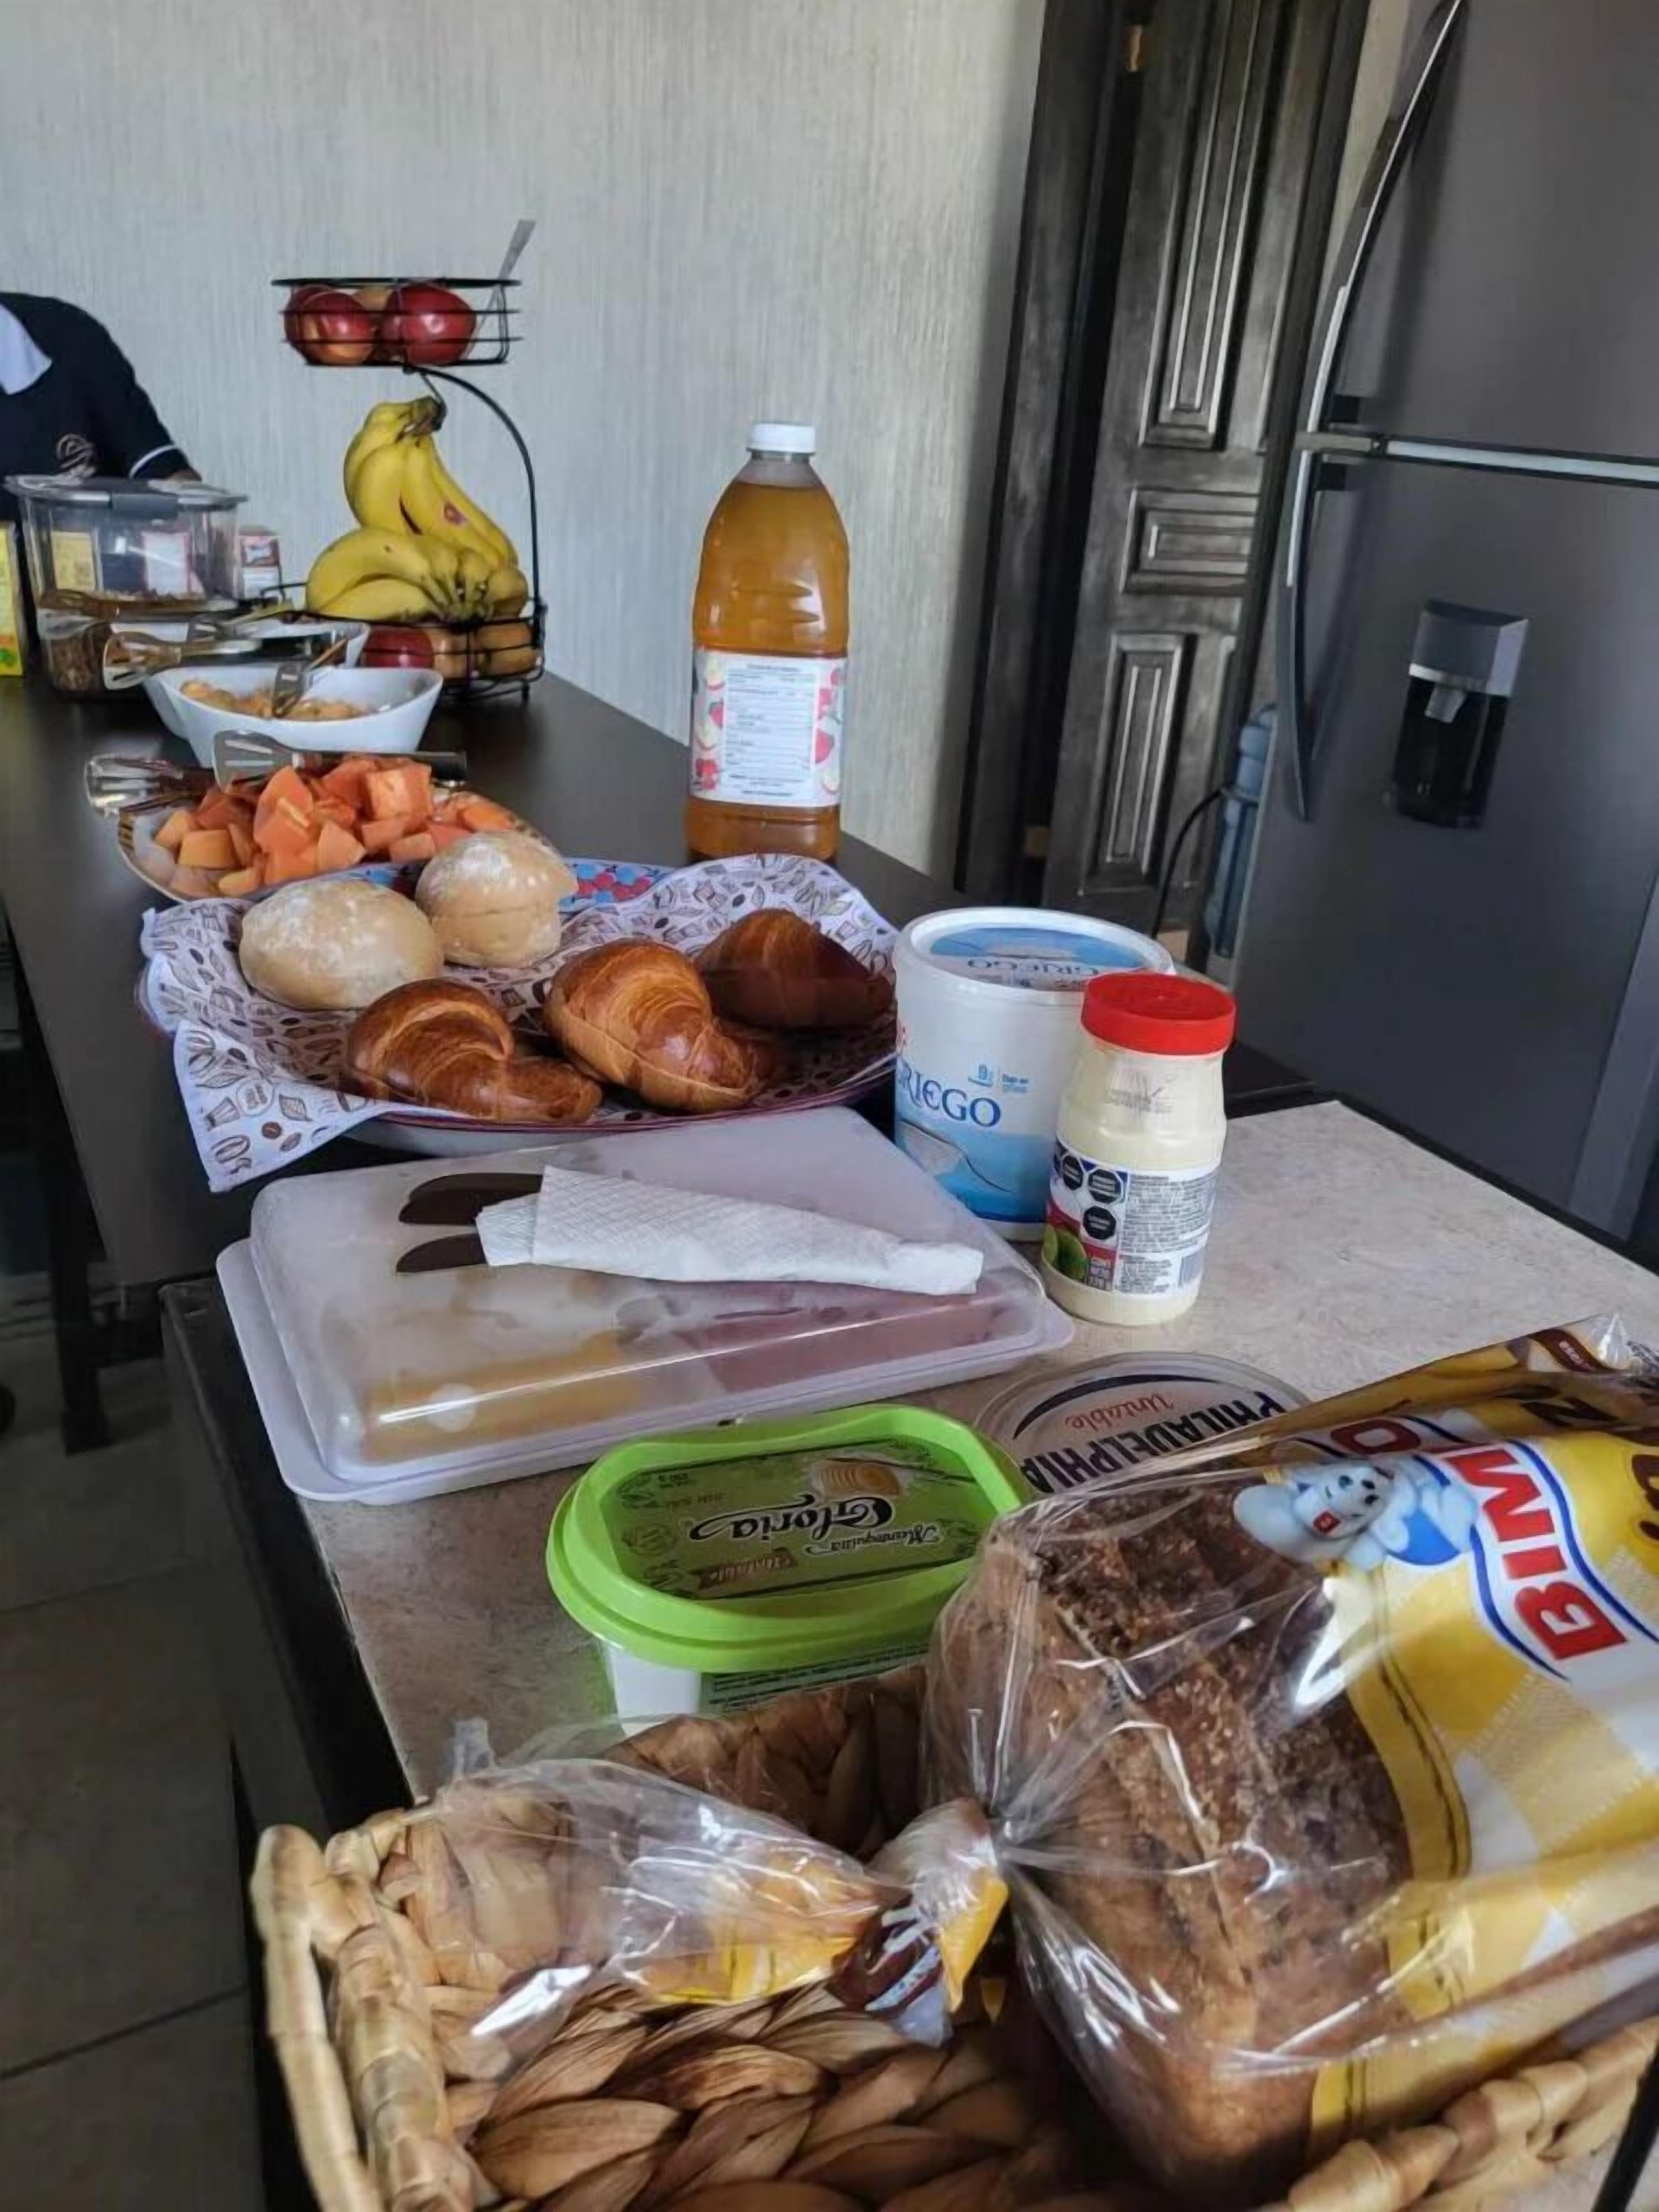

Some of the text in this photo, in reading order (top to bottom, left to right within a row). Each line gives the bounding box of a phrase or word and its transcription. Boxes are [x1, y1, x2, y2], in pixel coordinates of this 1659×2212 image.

[896, 1056, 1002, 1129] RIEGO
[1021, 1390, 1286, 1494] PHILADELPHIA
[1064, 1392, 1174, 1432] Untable
[688, 1493, 894, 1542] Gloria
